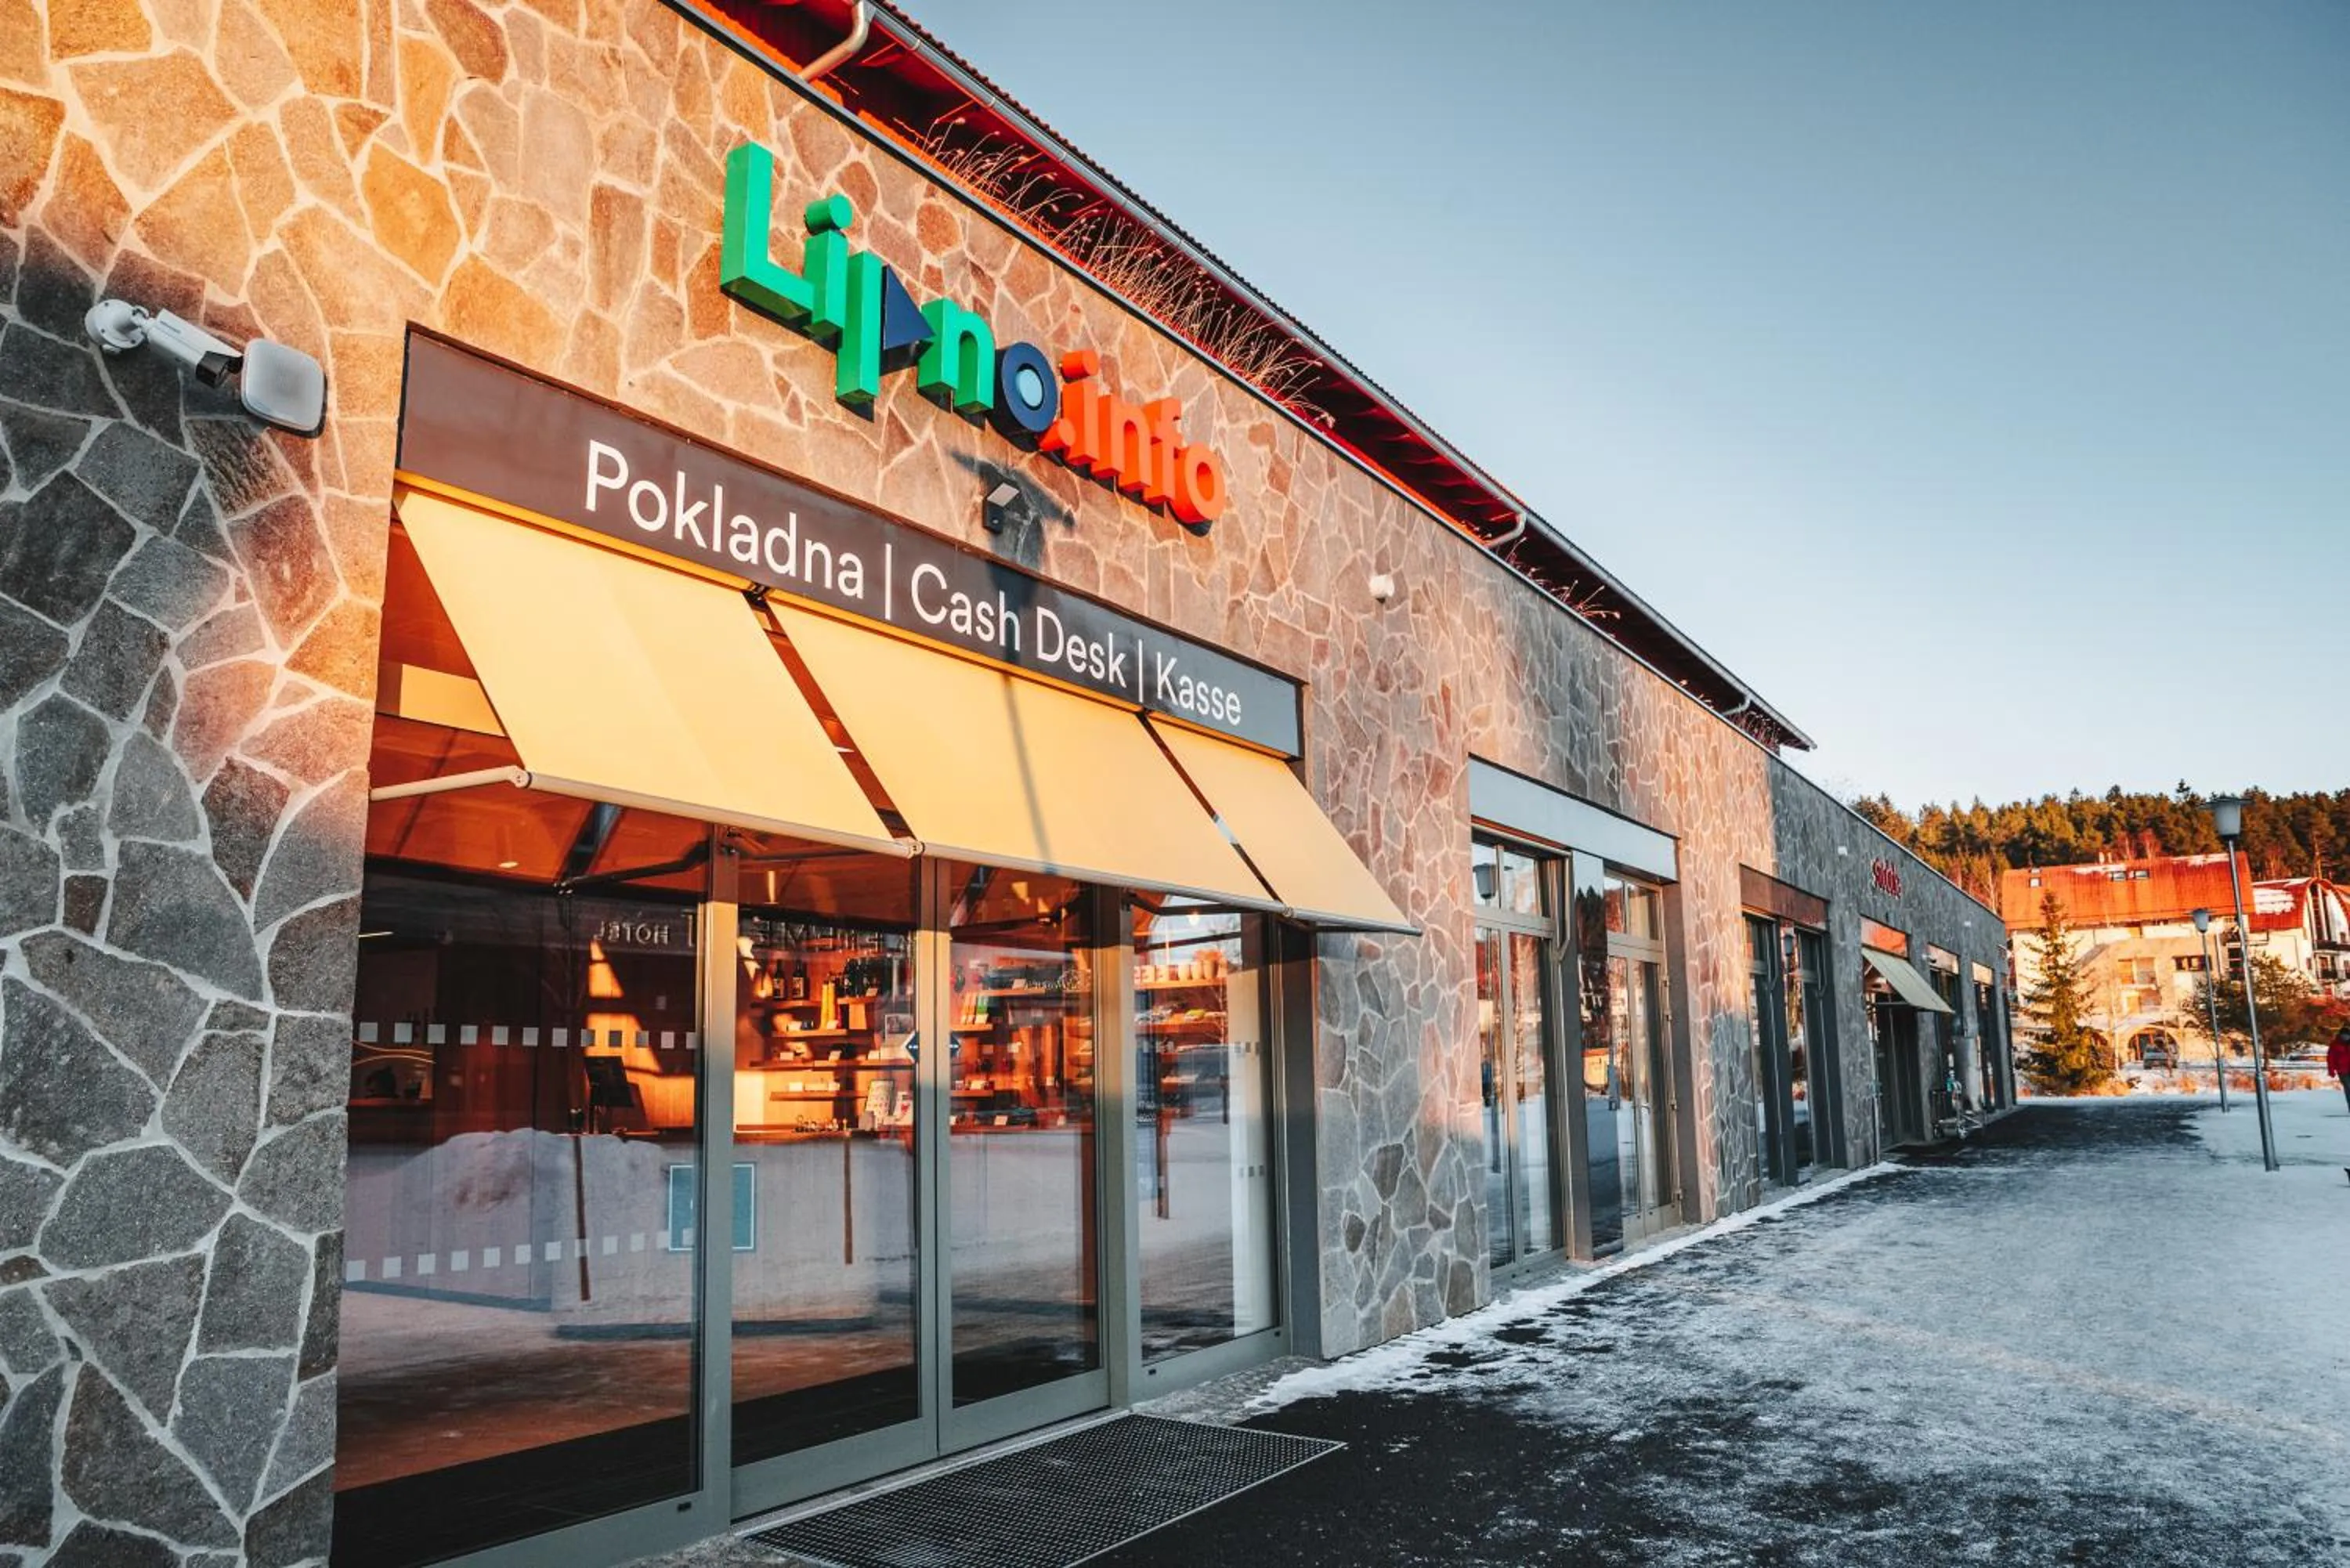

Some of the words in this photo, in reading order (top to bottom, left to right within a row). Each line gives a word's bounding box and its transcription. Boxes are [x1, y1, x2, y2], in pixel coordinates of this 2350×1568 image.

[584, 439, 864, 600] Pokladna
[911, 562, 1021, 652] Cash
[1036, 606, 1126, 688] Desk
[1156, 651, 1242, 726] Kasse
